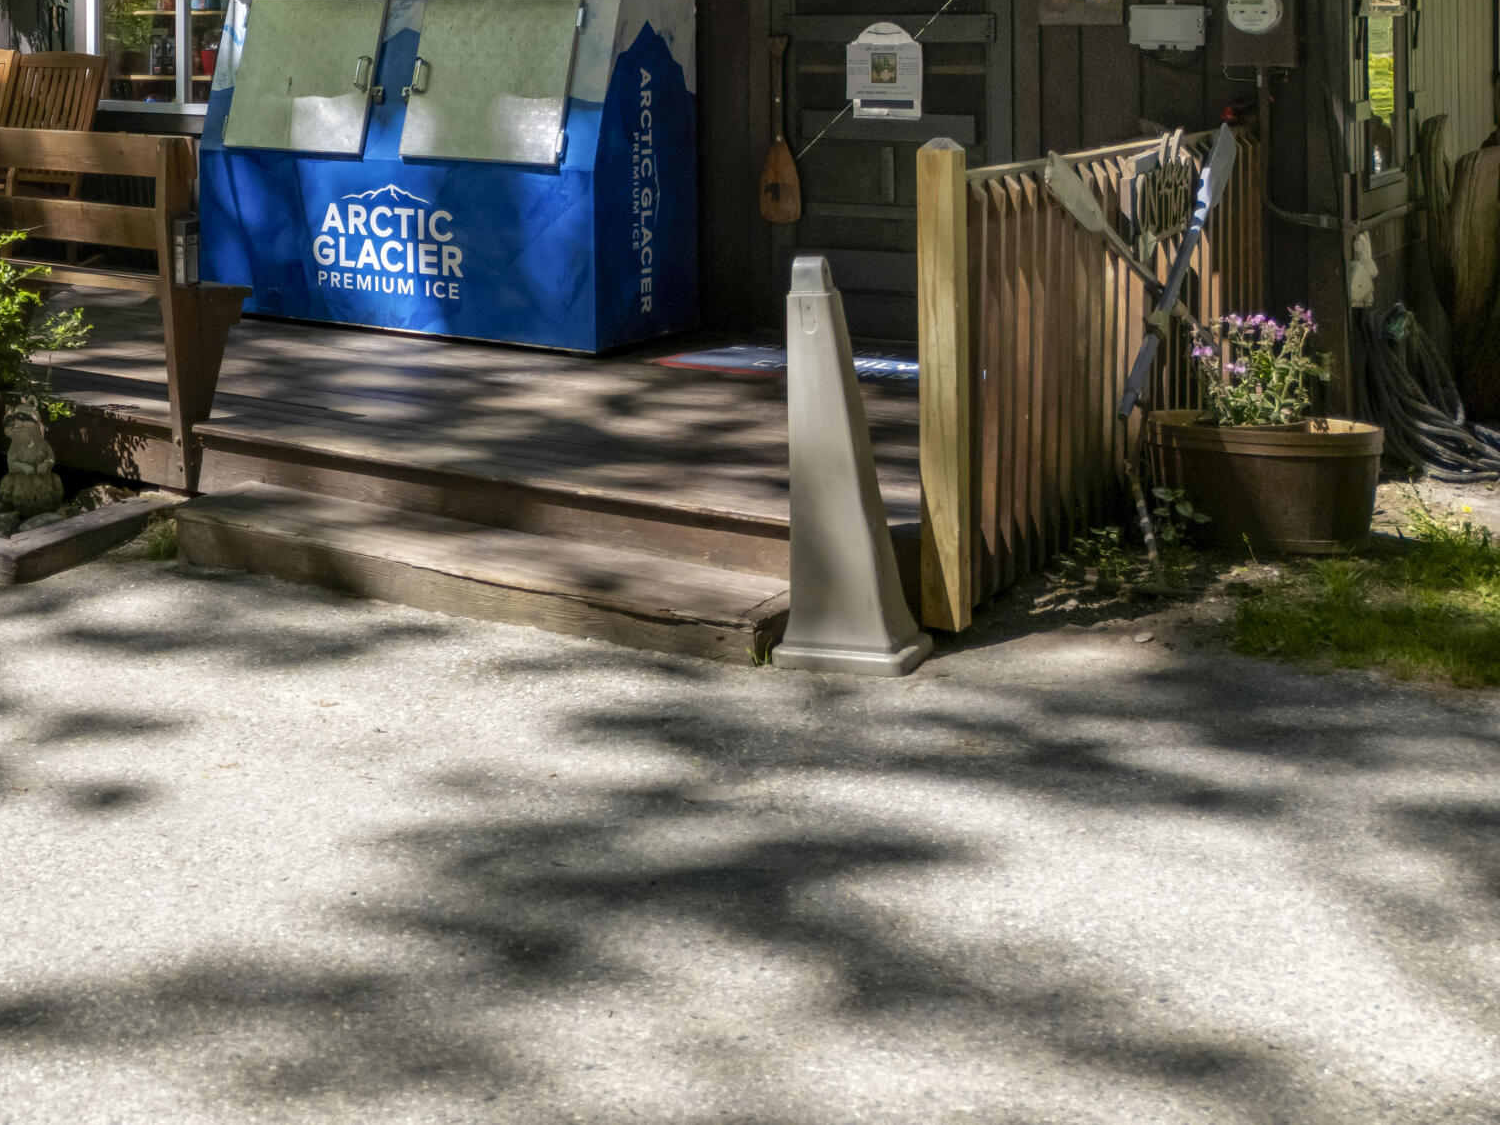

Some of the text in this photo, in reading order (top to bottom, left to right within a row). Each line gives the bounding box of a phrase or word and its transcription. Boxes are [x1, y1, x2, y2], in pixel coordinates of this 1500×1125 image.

[640, 68, 653, 313] ARCTIC GLACIER
[1136, 172, 1159, 233] ON
[321, 203, 453, 242] ARCTIC
[313, 235, 464, 278] GLACIER
[318, 271, 460, 299] PREMIUM ICE
